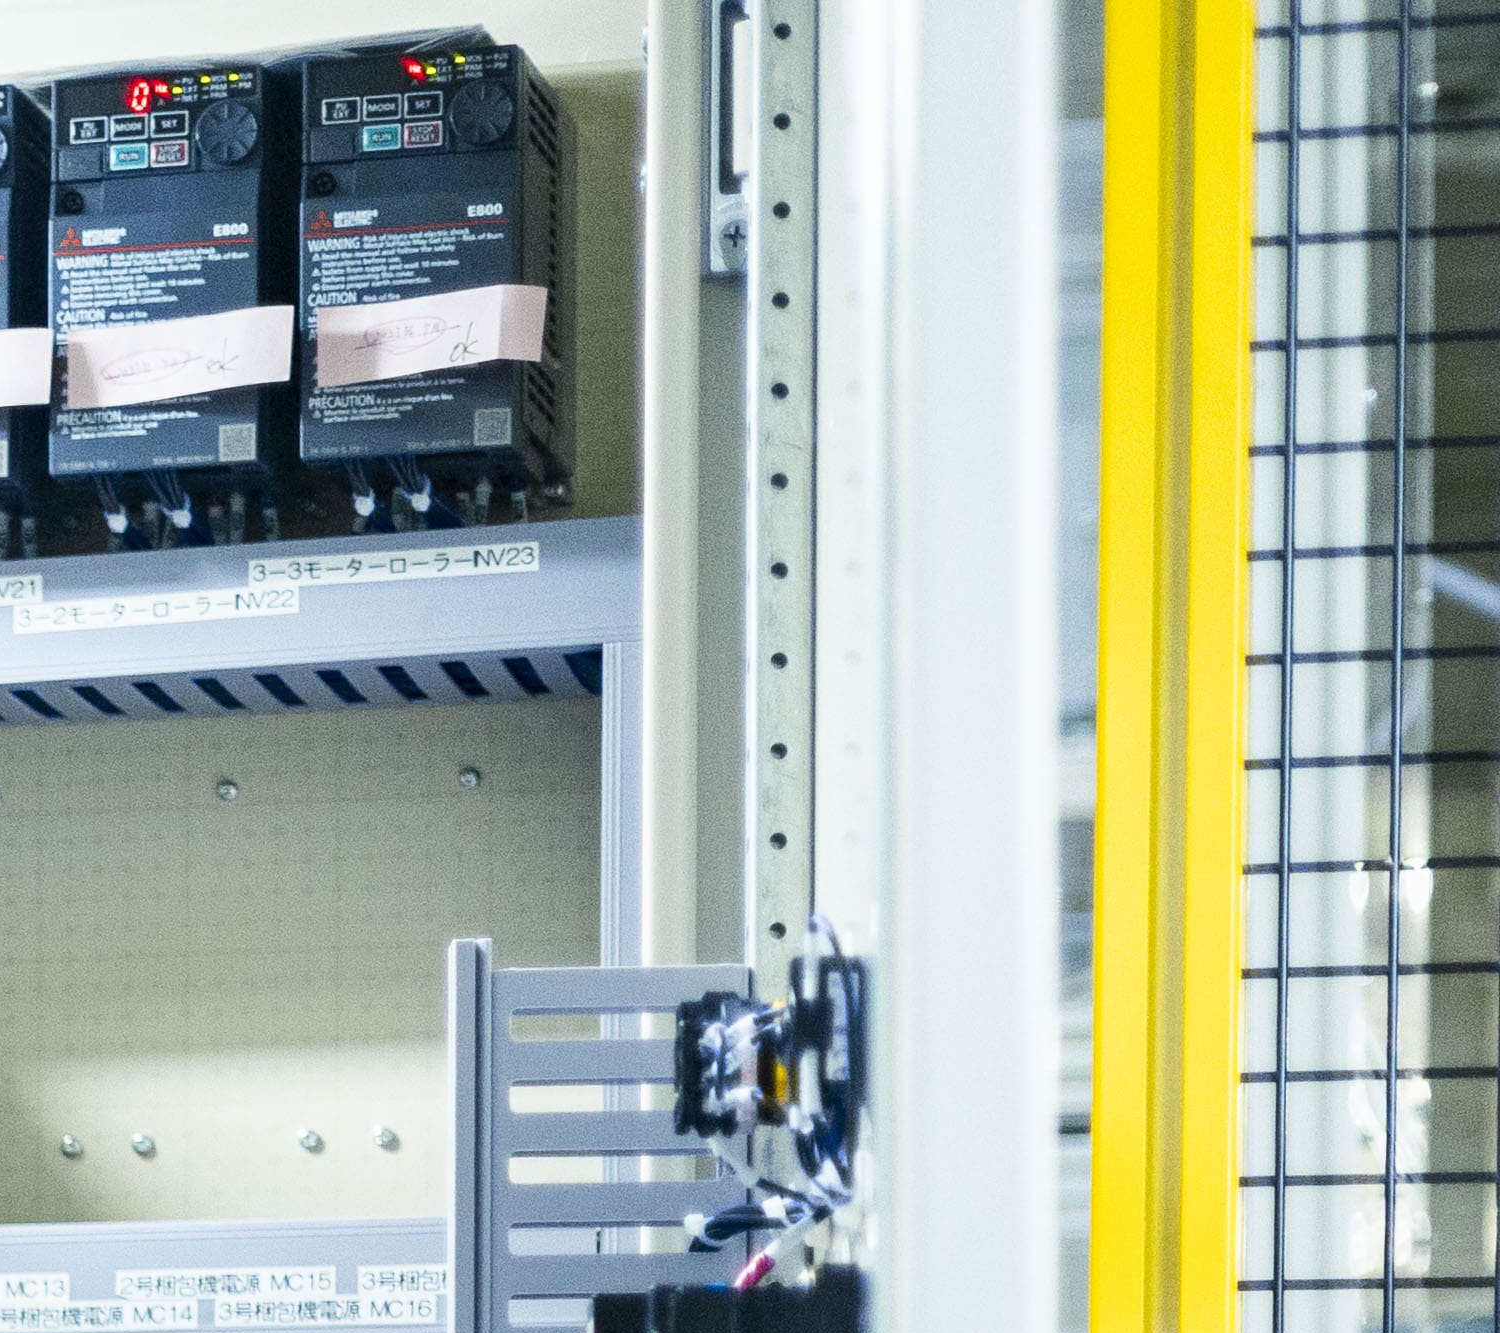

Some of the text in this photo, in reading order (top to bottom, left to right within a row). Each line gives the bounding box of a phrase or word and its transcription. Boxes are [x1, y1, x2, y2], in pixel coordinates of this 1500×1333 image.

[415, 101, 431, 109] SET
[467, 203, 503, 218] E800
[307, 237, 360, 253] WARNING
[307, 291, 357, 307] CAUTION
[362, 1268, 446, 1292] 3号梱包
